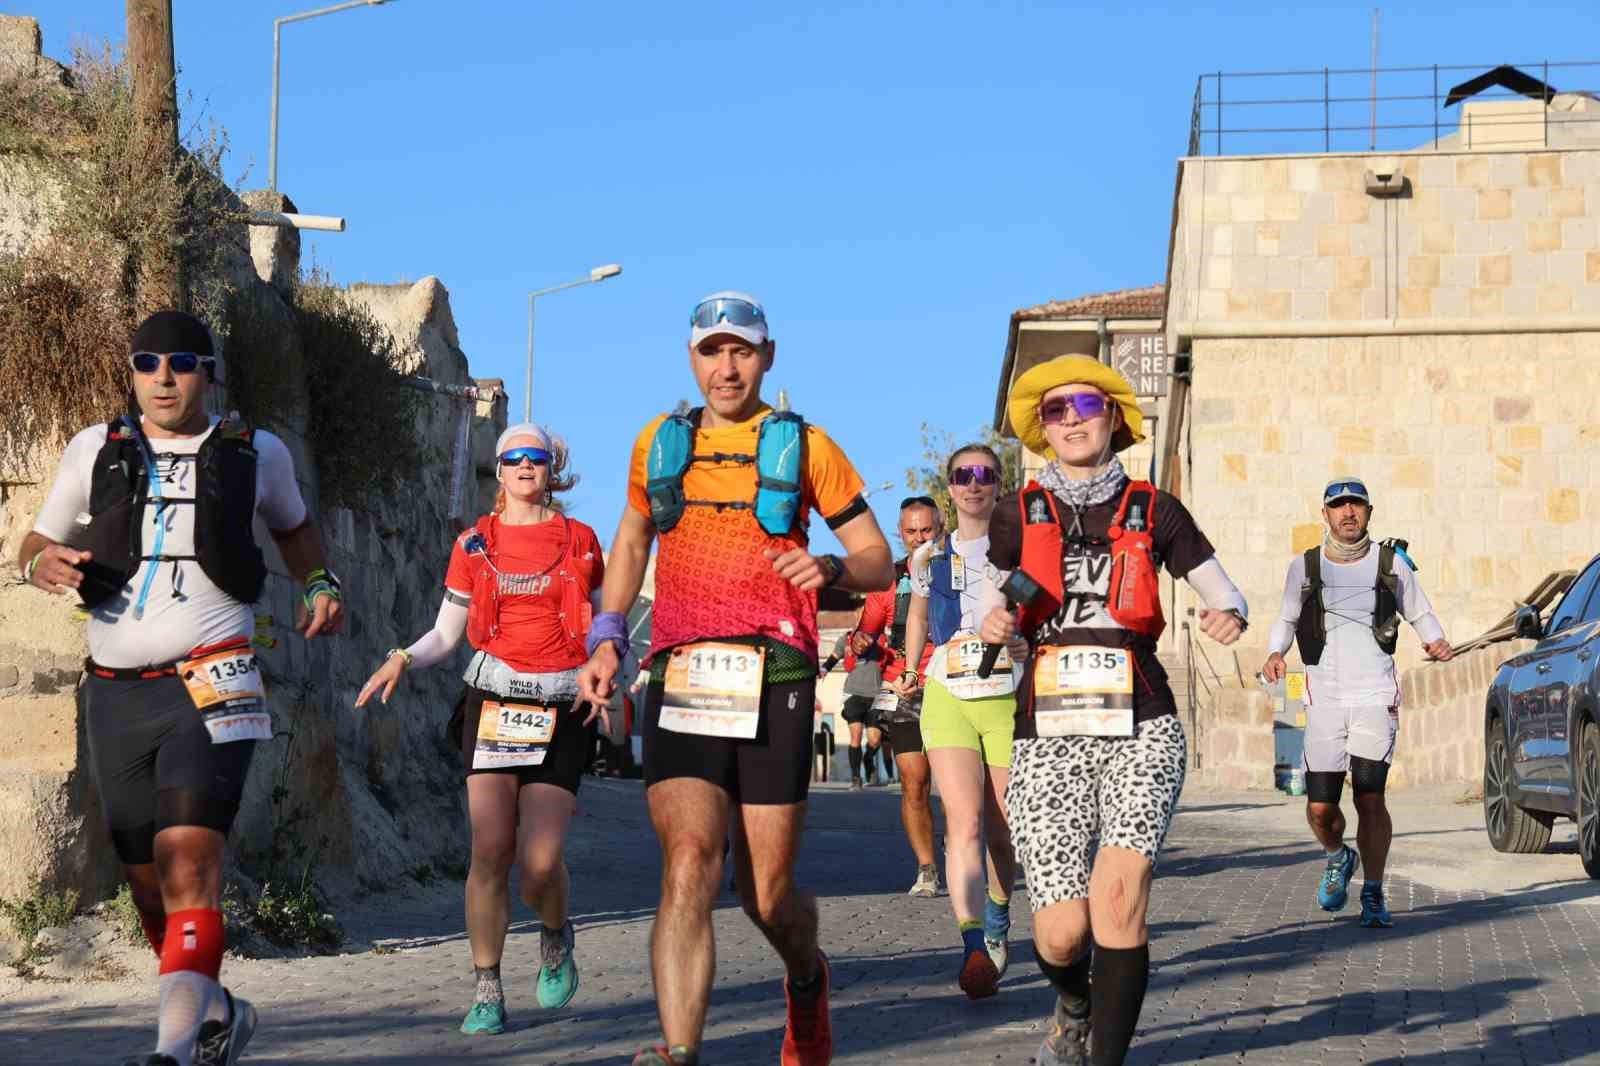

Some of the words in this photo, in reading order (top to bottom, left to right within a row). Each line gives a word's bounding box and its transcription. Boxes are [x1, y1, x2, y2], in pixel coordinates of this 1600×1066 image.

[1141, 337, 1163, 353] HE
[1141, 357, 1163, 373] RE
[691, 652, 749, 673] 1113
[1060, 652, 1117, 669] 1135
[509, 686, 532, 696] TRAIL
[510, 679, 533, 689] WILD
[501, 711, 545, 728] 1442
